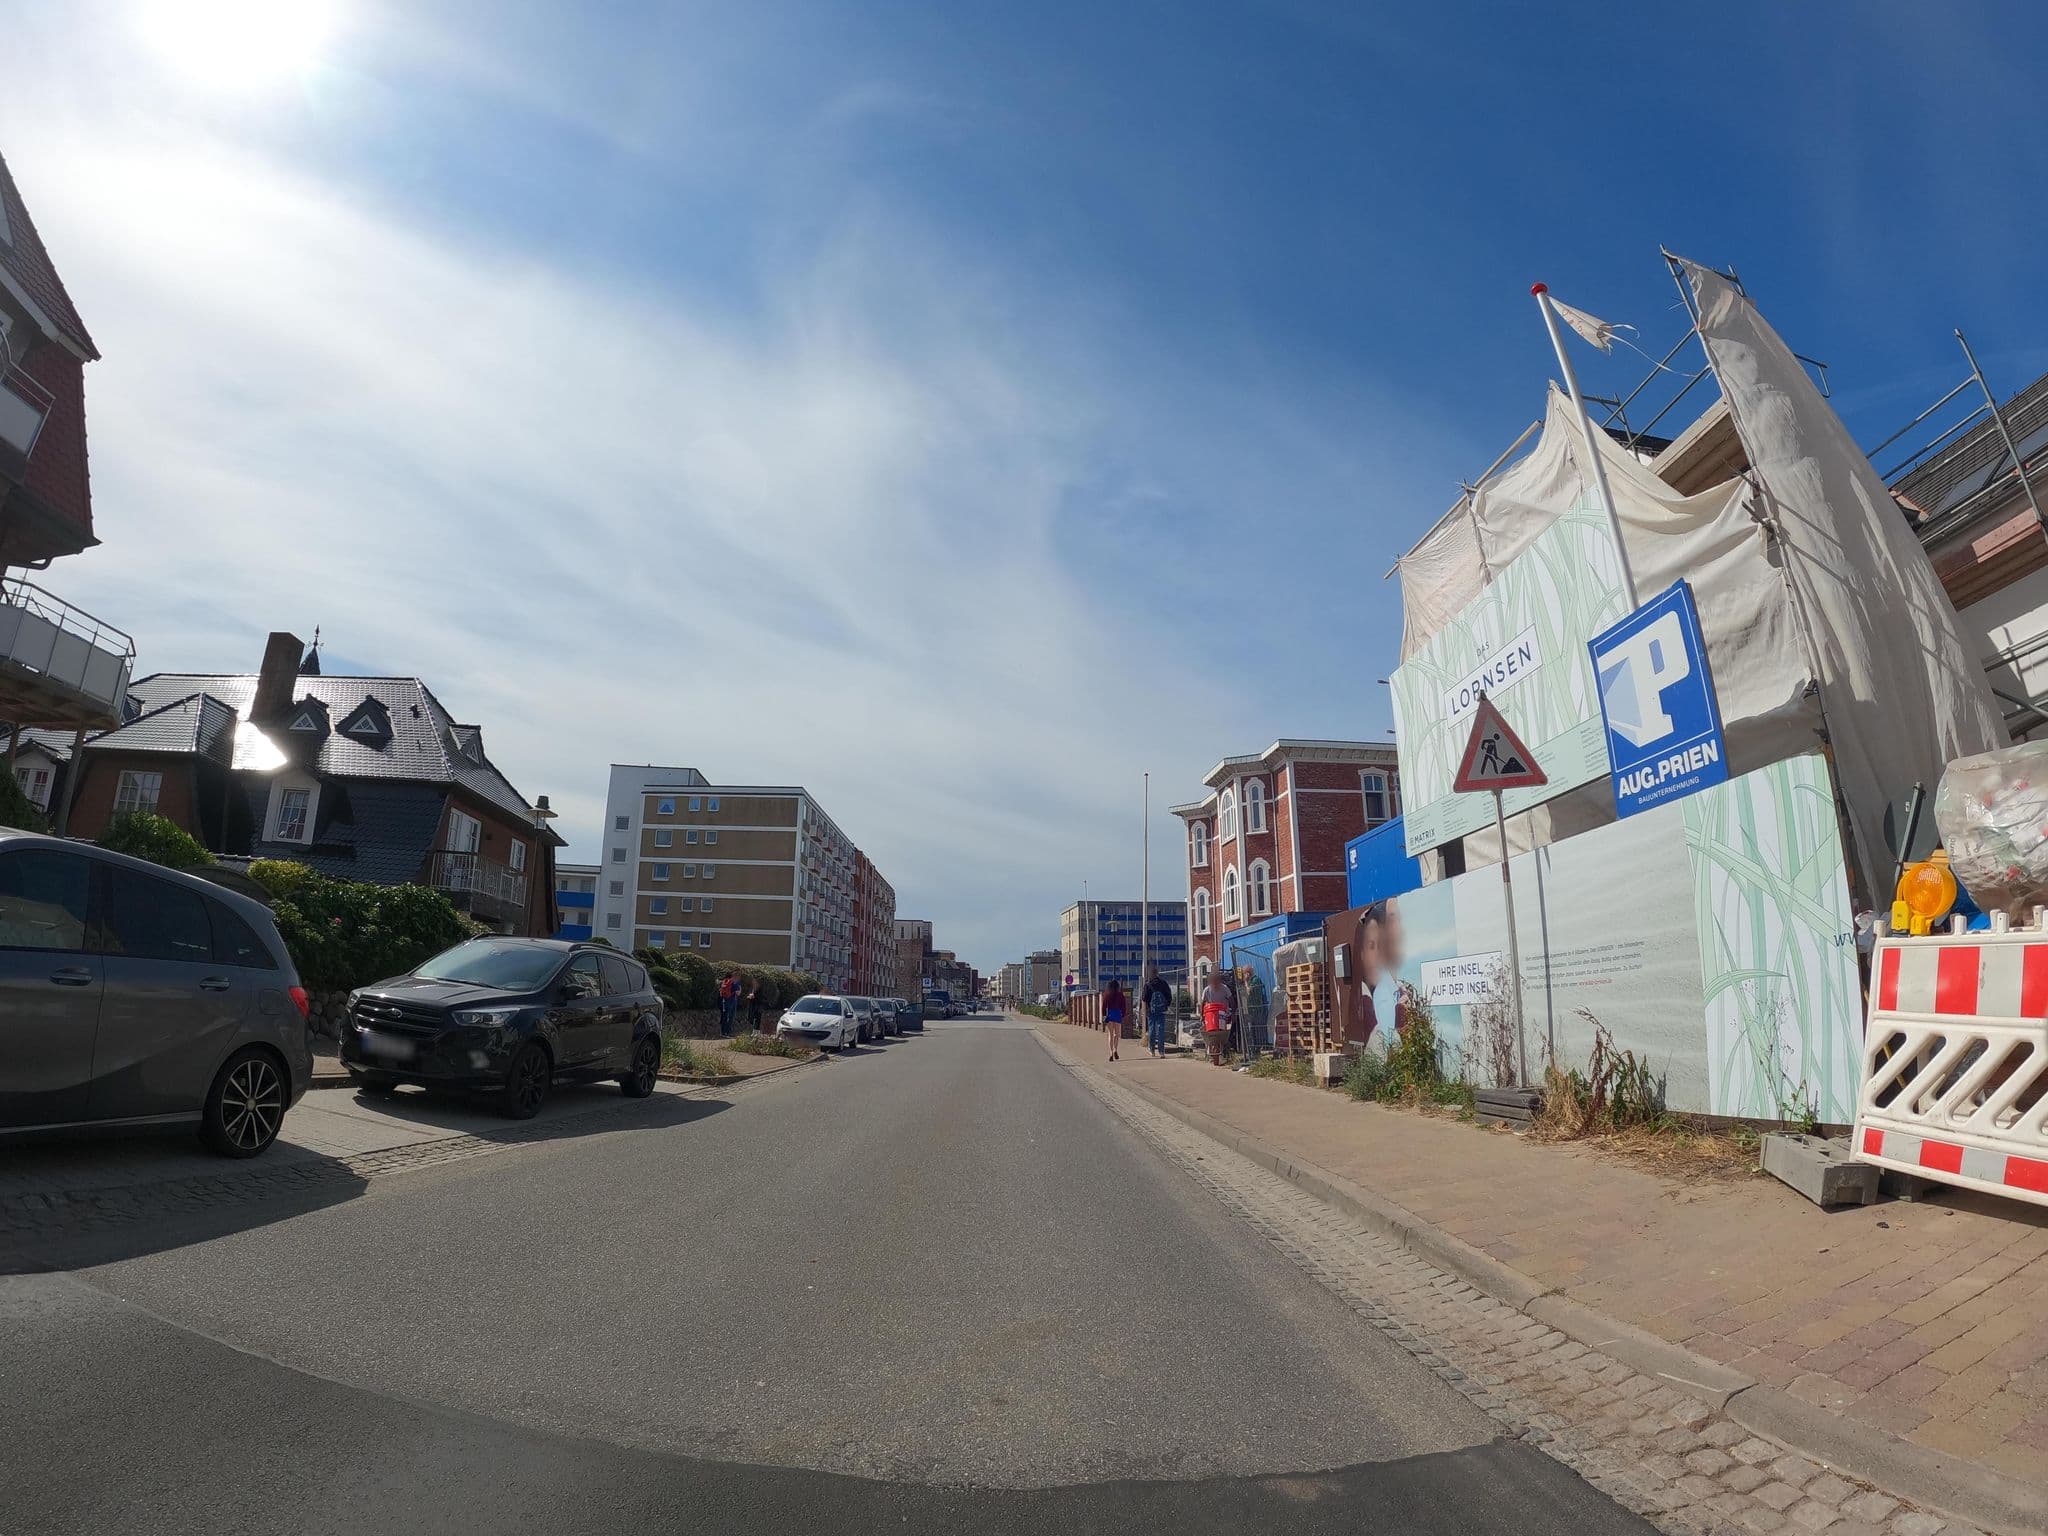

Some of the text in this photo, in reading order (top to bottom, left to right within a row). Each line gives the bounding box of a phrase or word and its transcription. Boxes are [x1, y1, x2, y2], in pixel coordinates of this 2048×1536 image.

[1476, 641, 1490, 657] DAS
[1451, 641, 1532, 715] LORNSEN
[1597, 610, 1690, 748] P
[1638, 775, 1700, 804] BAUUNTERNEHMUNG
[1414, 826, 1435, 845] MATRIX
[1439, 965, 1457, 979] IHRE
[1431, 984, 1447, 997] AUF
[1448, 983, 1465, 996] DER
